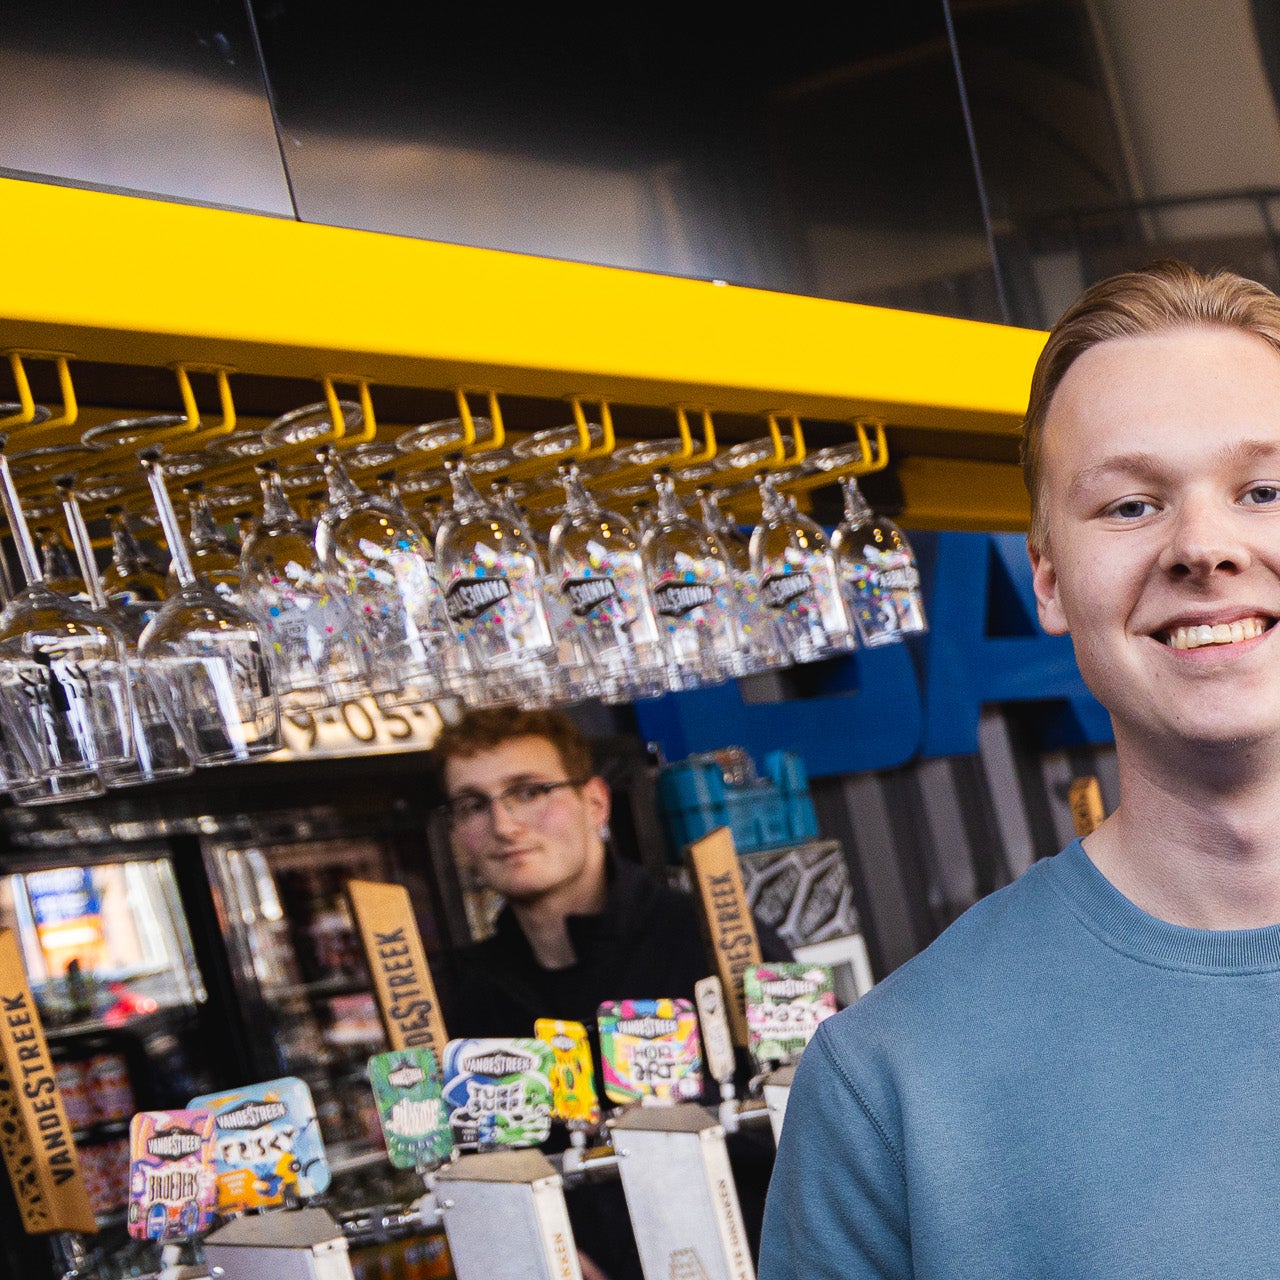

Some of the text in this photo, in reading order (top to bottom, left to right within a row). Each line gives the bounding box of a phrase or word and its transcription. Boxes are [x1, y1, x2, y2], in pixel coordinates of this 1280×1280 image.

[373, 926, 436, 1054] DESTREEK
[706, 870, 752, 1000] DESTREEK
[2, 991, 76, 1186] VANDESTREEK
[216, 1102, 285, 1129] VANDESTREEK
[463, 1055, 532, 1074] VANDESTREEK
